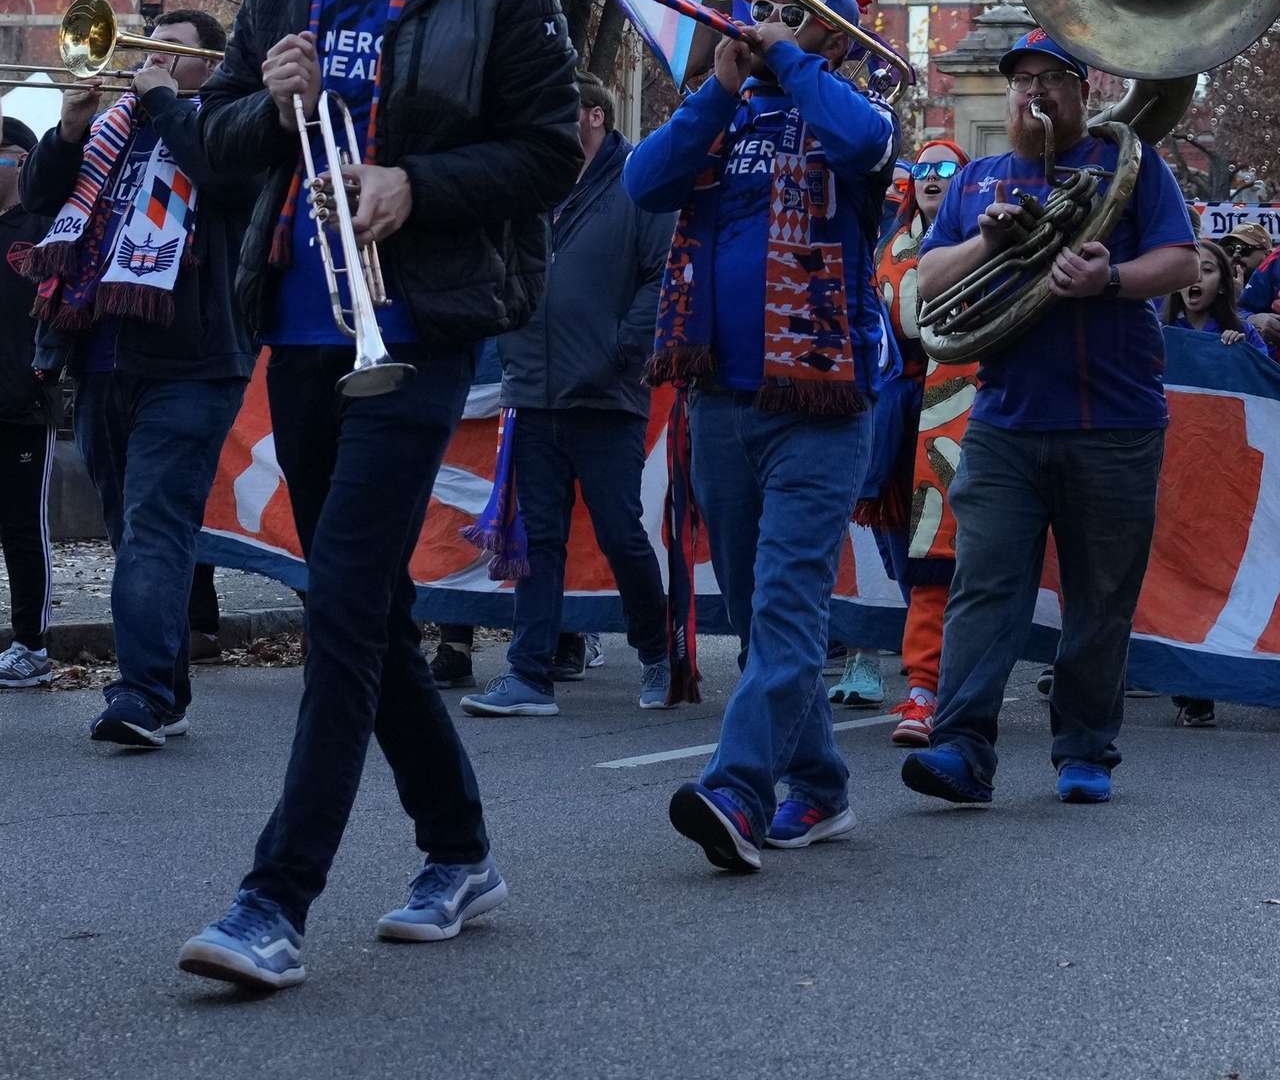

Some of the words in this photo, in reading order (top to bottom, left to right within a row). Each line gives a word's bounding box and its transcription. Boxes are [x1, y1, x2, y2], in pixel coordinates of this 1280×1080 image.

[325, 29, 384, 54] MERC
[323, 56, 377, 80] EAL
[730, 139, 776, 158] MER
